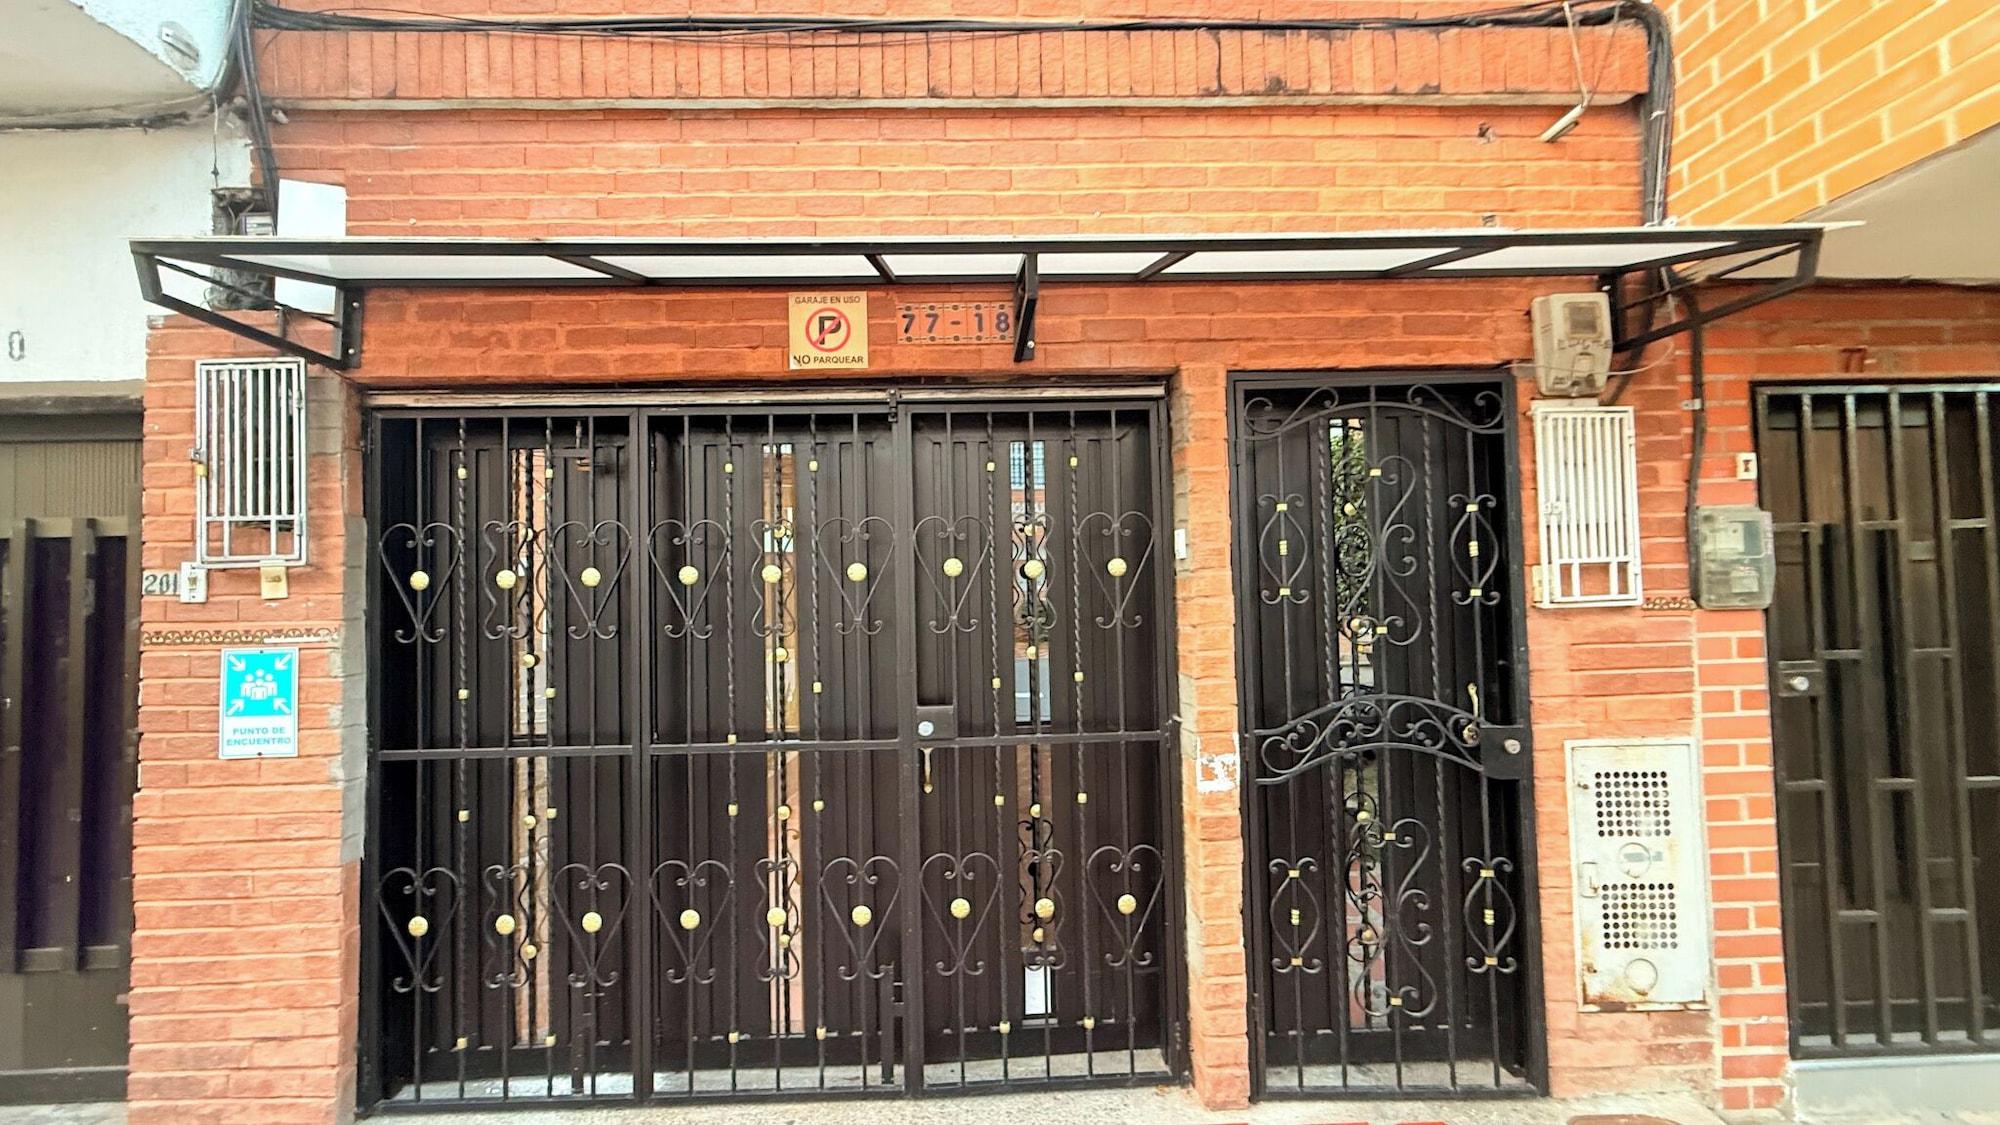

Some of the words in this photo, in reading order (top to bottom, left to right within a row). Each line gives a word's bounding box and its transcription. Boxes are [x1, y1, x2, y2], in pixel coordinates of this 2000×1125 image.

[795, 296, 829, 304] GARAJE
[830, 296, 841, 304] EN
[843, 296, 861, 304] USO
[902, 311, 1010, 334] 77-18
[793, 355, 811, 366] NO
[813, 355, 864, 364] PARQUEAR
[144, 573, 177, 594] 201
[232, 727, 269, 735] PUNTO
[226, 737, 291, 746] ENCUENTRO
